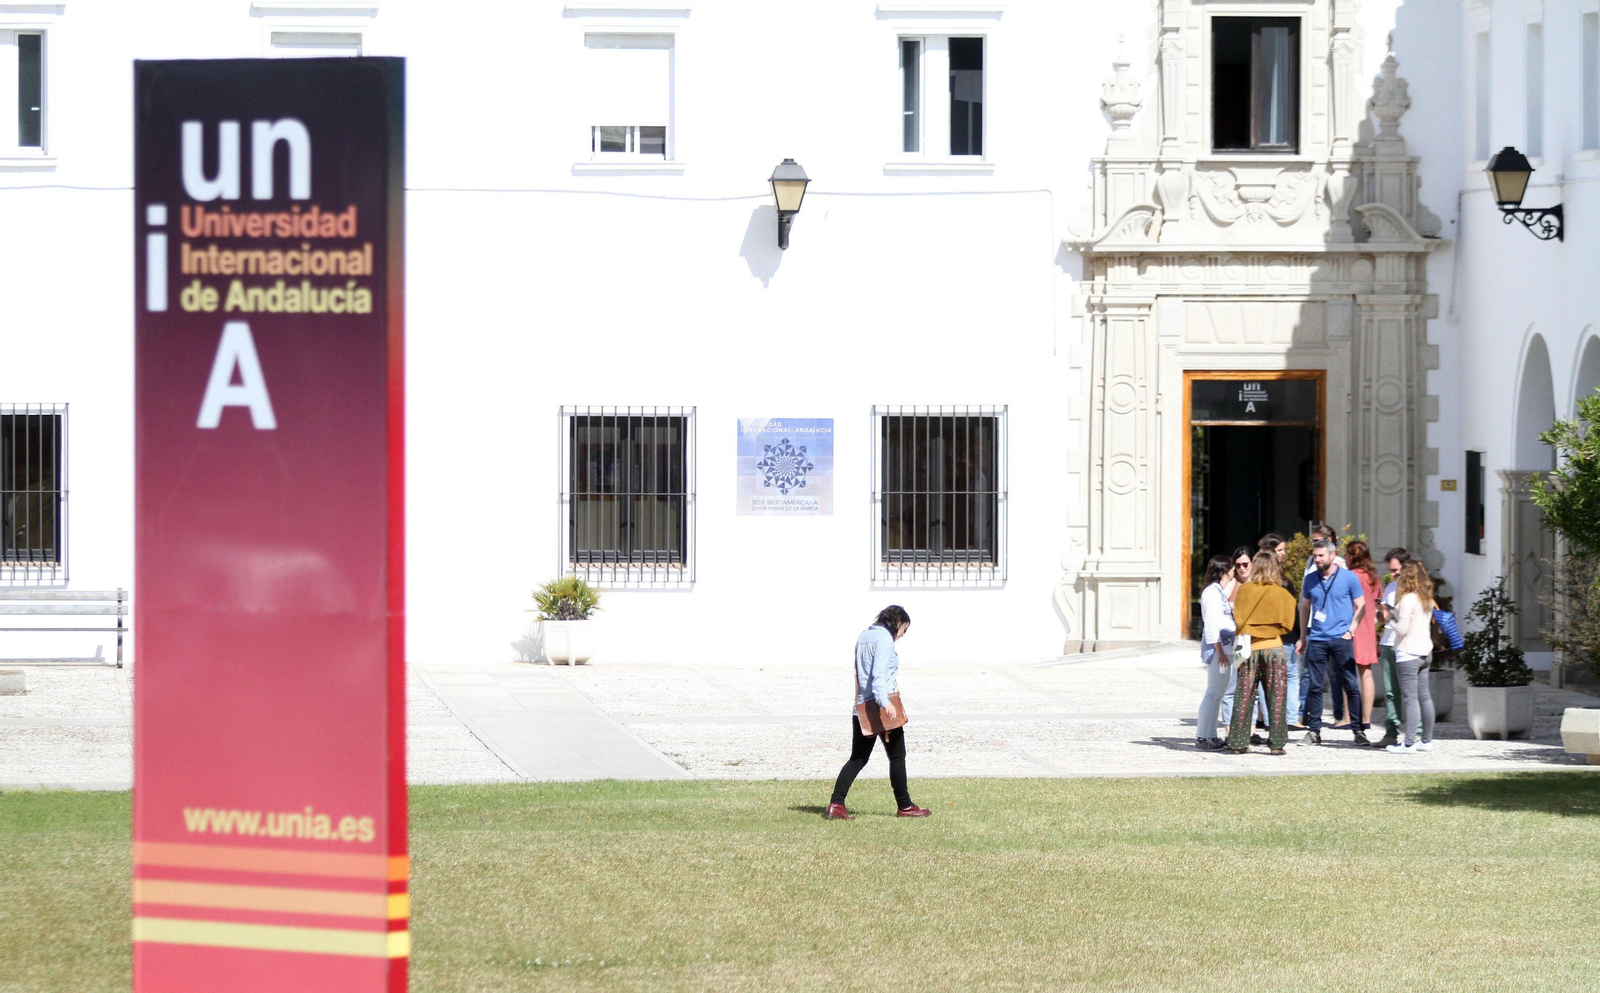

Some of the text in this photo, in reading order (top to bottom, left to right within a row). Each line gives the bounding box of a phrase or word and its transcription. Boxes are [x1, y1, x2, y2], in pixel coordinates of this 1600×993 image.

[181, 117, 311, 202] un
[180, 205, 357, 238] Universidad
[147, 204, 168, 312] i
[180, 243, 373, 276] Internacional
[180, 280, 373, 314] de Andalucía
[196, 320, 278, 431] A
[1245, 402, 1256, 412] A
[183, 805, 376, 843] www.unia.es
